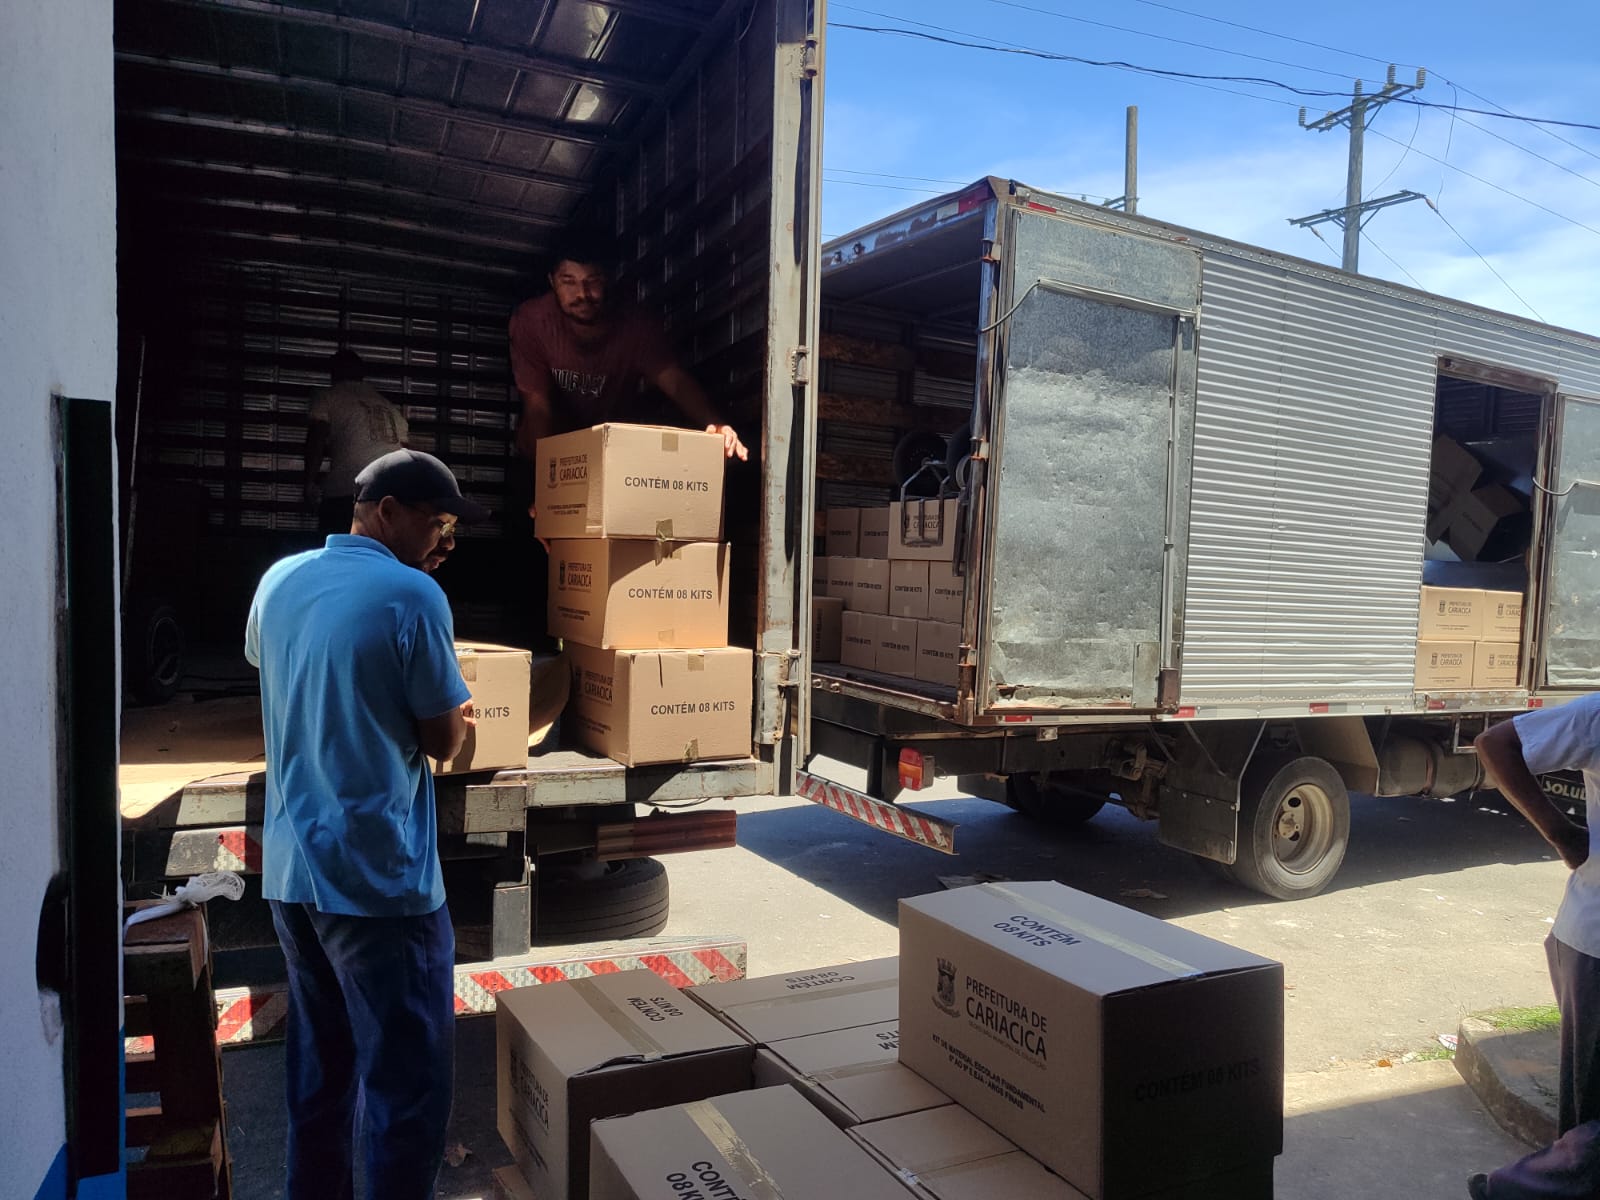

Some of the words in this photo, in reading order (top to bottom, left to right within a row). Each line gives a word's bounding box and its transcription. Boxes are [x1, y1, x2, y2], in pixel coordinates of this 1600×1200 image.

[624, 476, 670, 490] CONTÉM
[672, 479, 684, 491] 08
[686, 480, 709, 492] KITS
[628, 586, 674, 599] CONTÉM
[676, 588, 688, 600] 08
[690, 589, 713, 600] KITS
[485, 706, 510, 719] KITS
[650, 701, 696, 715] CONTÉM
[698, 702, 710, 713] 08
[712, 701, 735, 712] KITS
[993, 922, 1020, 933] 08
[1012, 930, 1053, 947] KITS
[1010, 915, 1082, 946] CONTÉM
[627, 997, 666, 1022] CONTÉM
[650, 997, 675, 1009] KITS
[966, 975, 1029, 1023] PREFEITURA
[1032, 1010, 1047, 1034] DE
[966, 996, 1047, 1061] CARIACICA
[1135, 1068, 1202, 1102] CONTÉM
[1228, 1056, 1262, 1081] KITS
[666, 1173, 694, 1191] 08
